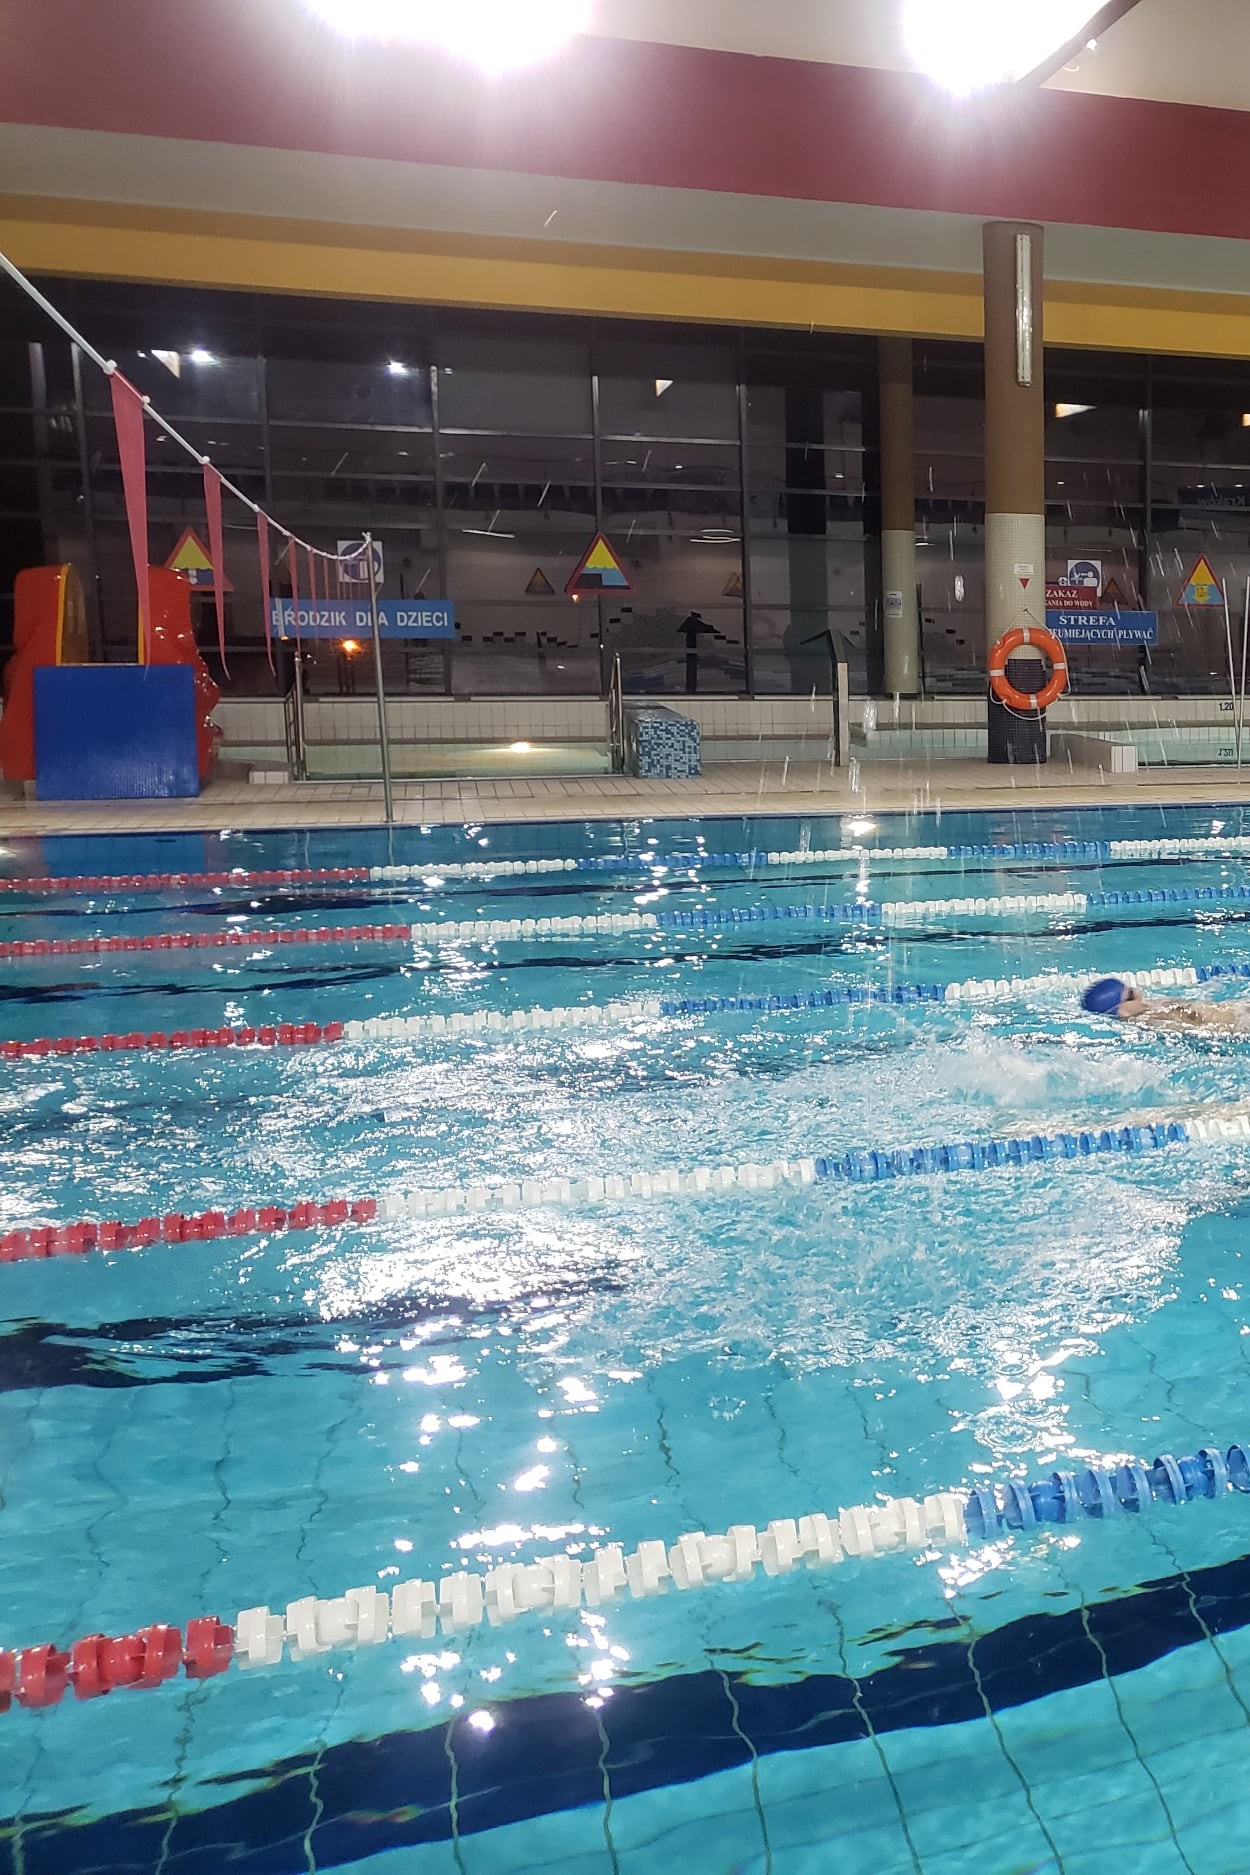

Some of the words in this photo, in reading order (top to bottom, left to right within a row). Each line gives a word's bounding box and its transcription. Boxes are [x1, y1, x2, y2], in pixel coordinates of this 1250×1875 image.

[1046, 589, 1078, 598] ZAKAZ
[1074, 600, 1093, 608] WODY
[396, 611, 448, 627] DZIECI
[1058, 615, 1116, 626] STREFA
